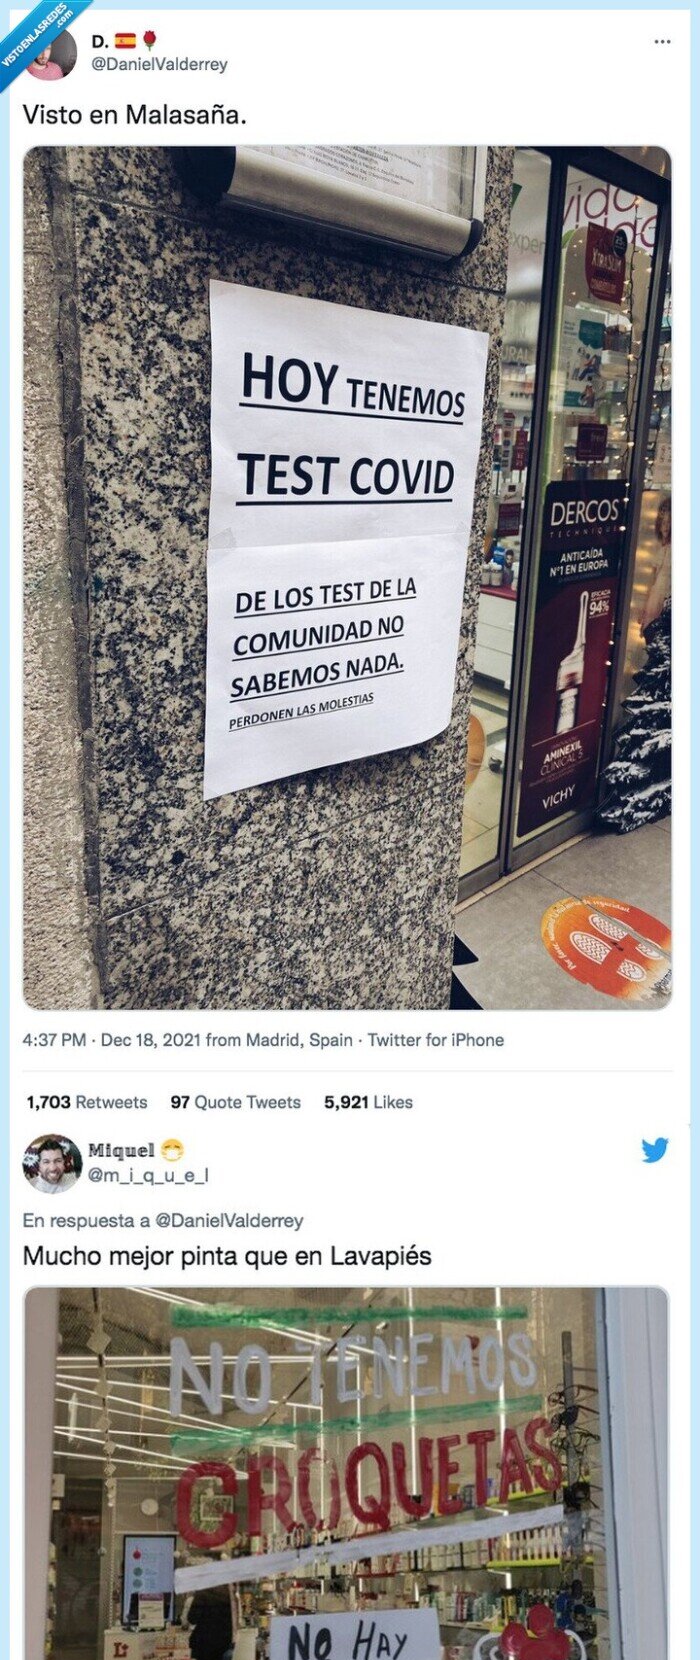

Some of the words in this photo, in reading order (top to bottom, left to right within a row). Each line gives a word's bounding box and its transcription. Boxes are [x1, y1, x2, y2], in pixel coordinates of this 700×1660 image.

[92, 35, 109, 48] D.
[92, 57, 228, 74] @DanielValderrey
[22, 104, 82, 124] Visto
[90, 110, 117, 124] en
[127, 104, 246, 124] Malasaña.
[243, 352, 339, 405] HOY
[346, 378, 465, 417] TENEMOS
[237, 453, 340, 495] TEST
[350, 457, 455, 495] COVID
[550, 499, 620, 526] DERCOS
[565, 563, 577, 575] EN
[578, 559, 609, 573] EUROPA
[236, 591, 267, 613] DE
[274, 586, 314, 610] LOS
[319, 582, 365, 604] TEST
[370, 579, 392, 600] DE
[397, 577, 417, 595] LA
[589, 600, 610, 616] 94%
[233, 619, 373, 656] COMUNIDAD
[378, 615, 405, 636] NO
[230, 662, 341, 698] SABEMOS
[346, 652, 405, 679] NADA.
[229, 708, 294, 730] PERDONEN
[297, 704, 317, 718] LAS
[319, 692, 375, 712] MOLESTIAS
[543, 740, 582, 764] AMINEXIL
[540, 756, 577, 776] CLINICAL
[542, 784, 576, 809] VICHY
[23, 1033, 57, 1046] 4:37
[62, 1033, 86, 1046] PM
[102, 1033, 131, 1046] Dec
[136, 1033, 157, 1048] 18,
[163, 1033, 199, 1046] 2021
[206, 1033, 240, 1046] from
[247, 1033, 304, 1048] Madrid,
[310, 1033, 352, 1050] Spain
[368, 1033, 421, 1046] Twitter
[426, 1033, 447, 1046] for
[452, 1033, 504, 1046] iPhone
[27, 1095, 71, 1111] 1,703
[76, 1095, 147, 1109] Retweets
[171, 1095, 190, 1109] 97
[195, 1095, 241, 1111] Quote
[246, 1095, 301, 1109] Tweets
[325, 1095, 368, 1111] 5,921
[374, 1095, 413, 1109] Likes
[89, 1143, 154, 1161] Miquel
[88, 1167, 208, 1185] @m_i_q_u_e_l
[24, 1213, 44, 1227] En
[51, 1214, 134, 1231] respuesta
[140, 1217, 150, 1227] a
[156, 1213, 303, 1231] @DanielValderrey
[24, 1245, 101, 1265] Mucho
[110, 1246, 174, 1270] mejor
[182, 1246, 237, 1270] pinta
[245, 1250, 287, 1270] que
[295, 1250, 321, 1265] en
[331, 1244, 432, 1270] Lavapiés
[169, 1336, 272, 1418] NO
[295, 1331, 538, 1406] TENEMOS
[176, 1417, 562, 1549] CROQUETAS
